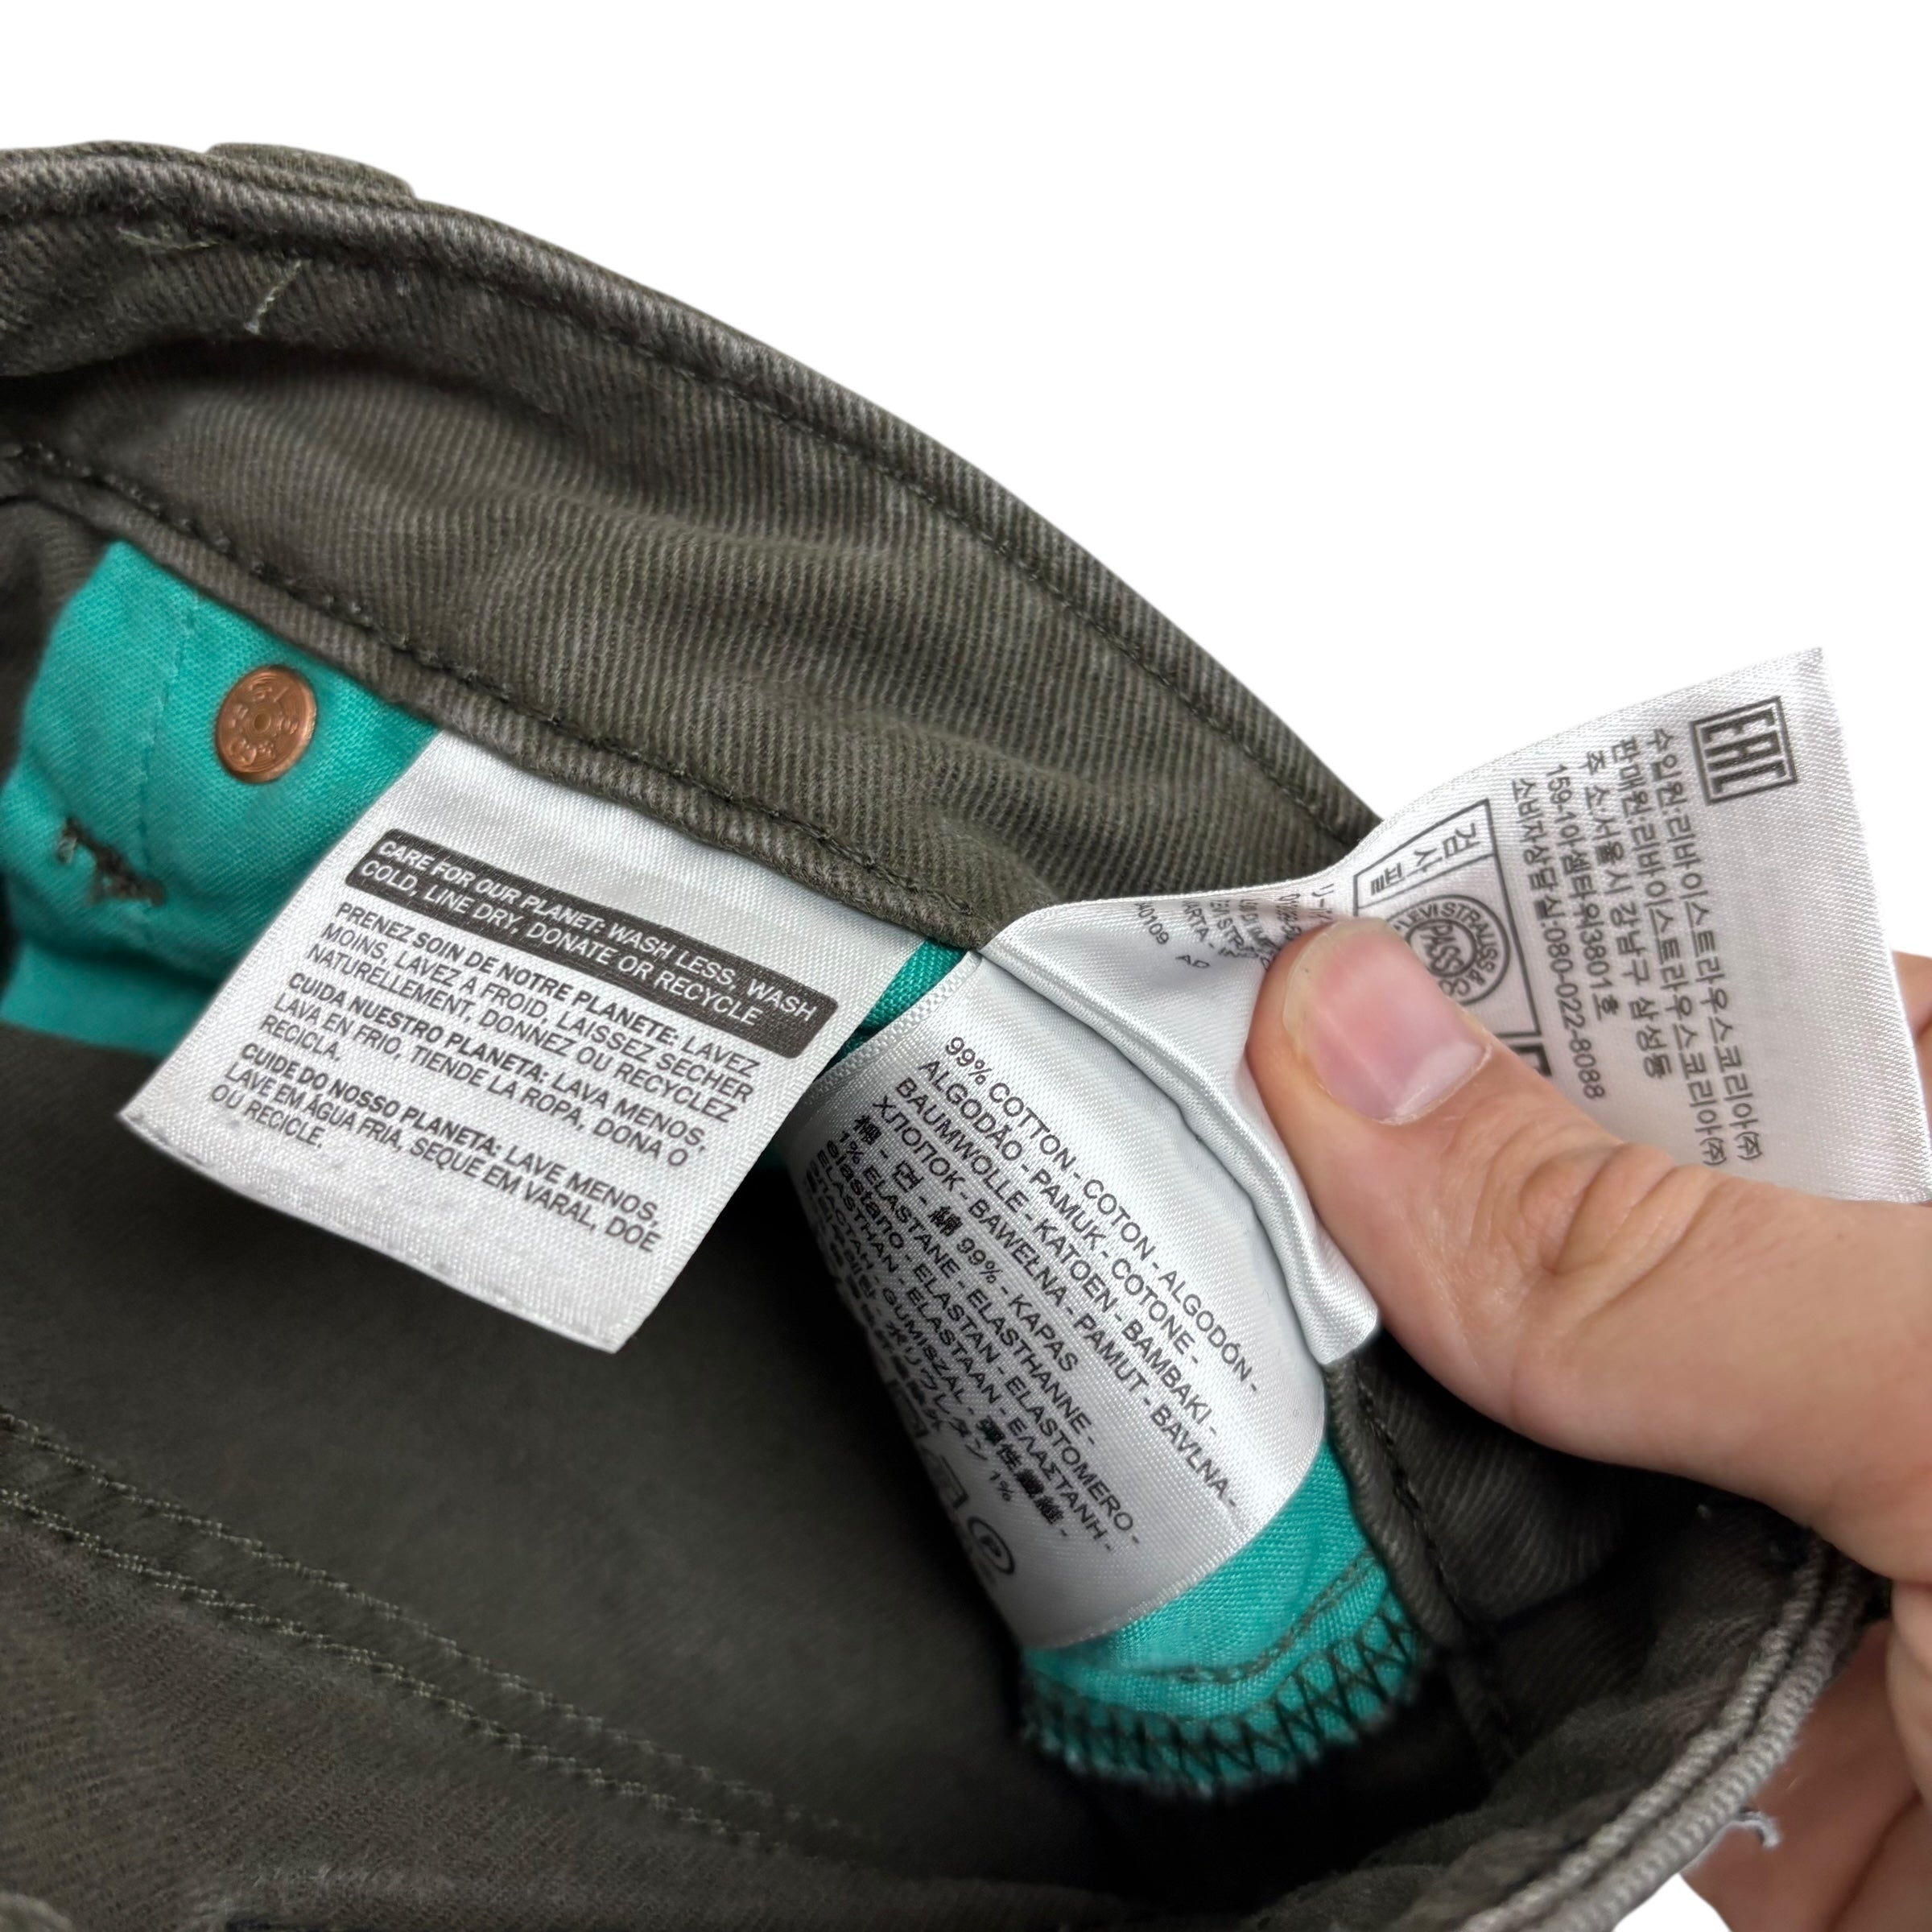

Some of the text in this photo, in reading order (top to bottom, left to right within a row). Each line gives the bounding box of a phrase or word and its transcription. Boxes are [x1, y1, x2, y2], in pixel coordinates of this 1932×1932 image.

[320, 923, 753, 1103] MOINS, LAVEZ A FROID, LAISSEZ SECHER
[335, 902, 761, 1078] PRENEZ SOIN DE NOTRE PLANETE: LAVEZ
[361, 861, 763, 1025] COLD, LINE DRY, DONATE OR RECYCLE
[378, 841, 816, 1021] CARE FOR OUR PLANET: WASH LESS, WASH
[1418, 923, 1464, 973] PASS
[1610, 902, 1650, 985] 강남구
[210, 1084, 325, 1148] OU RECICLE.
[259, 1013, 340, 1062] RECICLA.
[274, 993, 688, 1166] LAVA EN FRIO, TIENDE LA ROPA, DONA O
[289, 972, 705, 1152] CUIDA NUESTRO PLANETA: LAVA MENOS,
[307, 943, 737, 1123] NATURELLEMENT, DONNEZ OU RECYCLEZ
[1629, 997, 1672, 1079] 삼성동
[225, 1062, 661, 1252] LAVE EM ÁGUA FRIA, SEQUE EM VARAL, DOE
[241, 1043, 658, 1228] CUIDE DO NOSSO PLANETA: LAVE MENOS,
[918, 1060, 1022, 1161] ALGODÃO
[1029, 1168, 1106, 1251] PAMUK
[1112, 1257, 1195, 1355] COTONE
[945, 1037, 992, 1085] 99%
[989, 1083, 1076, 1171] COTTON
[1083, 1179, 1156, 1261] COTON
[1158, 1271, 1252, 1382] ALGODÓN
[811, 1149, 898, 1273] ELASTHAN
[905, 1286, 1001, 1404] ELASTAAN
[820, 1140, 904, 1249] elastano
[911, 1262, 1001, 1364] ELASTAN
[1004, 1375, 1133, 1530] ELASTOMERO
[857, 1164, 960, 1278] ELASTANE
[966, 1288, 1092, 1435] ELASTHANNE
[894, 1077, 1029, 1213] BAUMWOLLE
[1032, 1218, 1118, 1313] KATOEN
[1121, 1319, 1212, 1425] BAMBAKI
[956, 1237, 1001, 1284] 99%
[1008, 1294, 1078, 1371] KAPAS
[1073, 1313, 1149, 1392] PAMUT
[1150, 1403, 1228, 1500] BAVLNA
